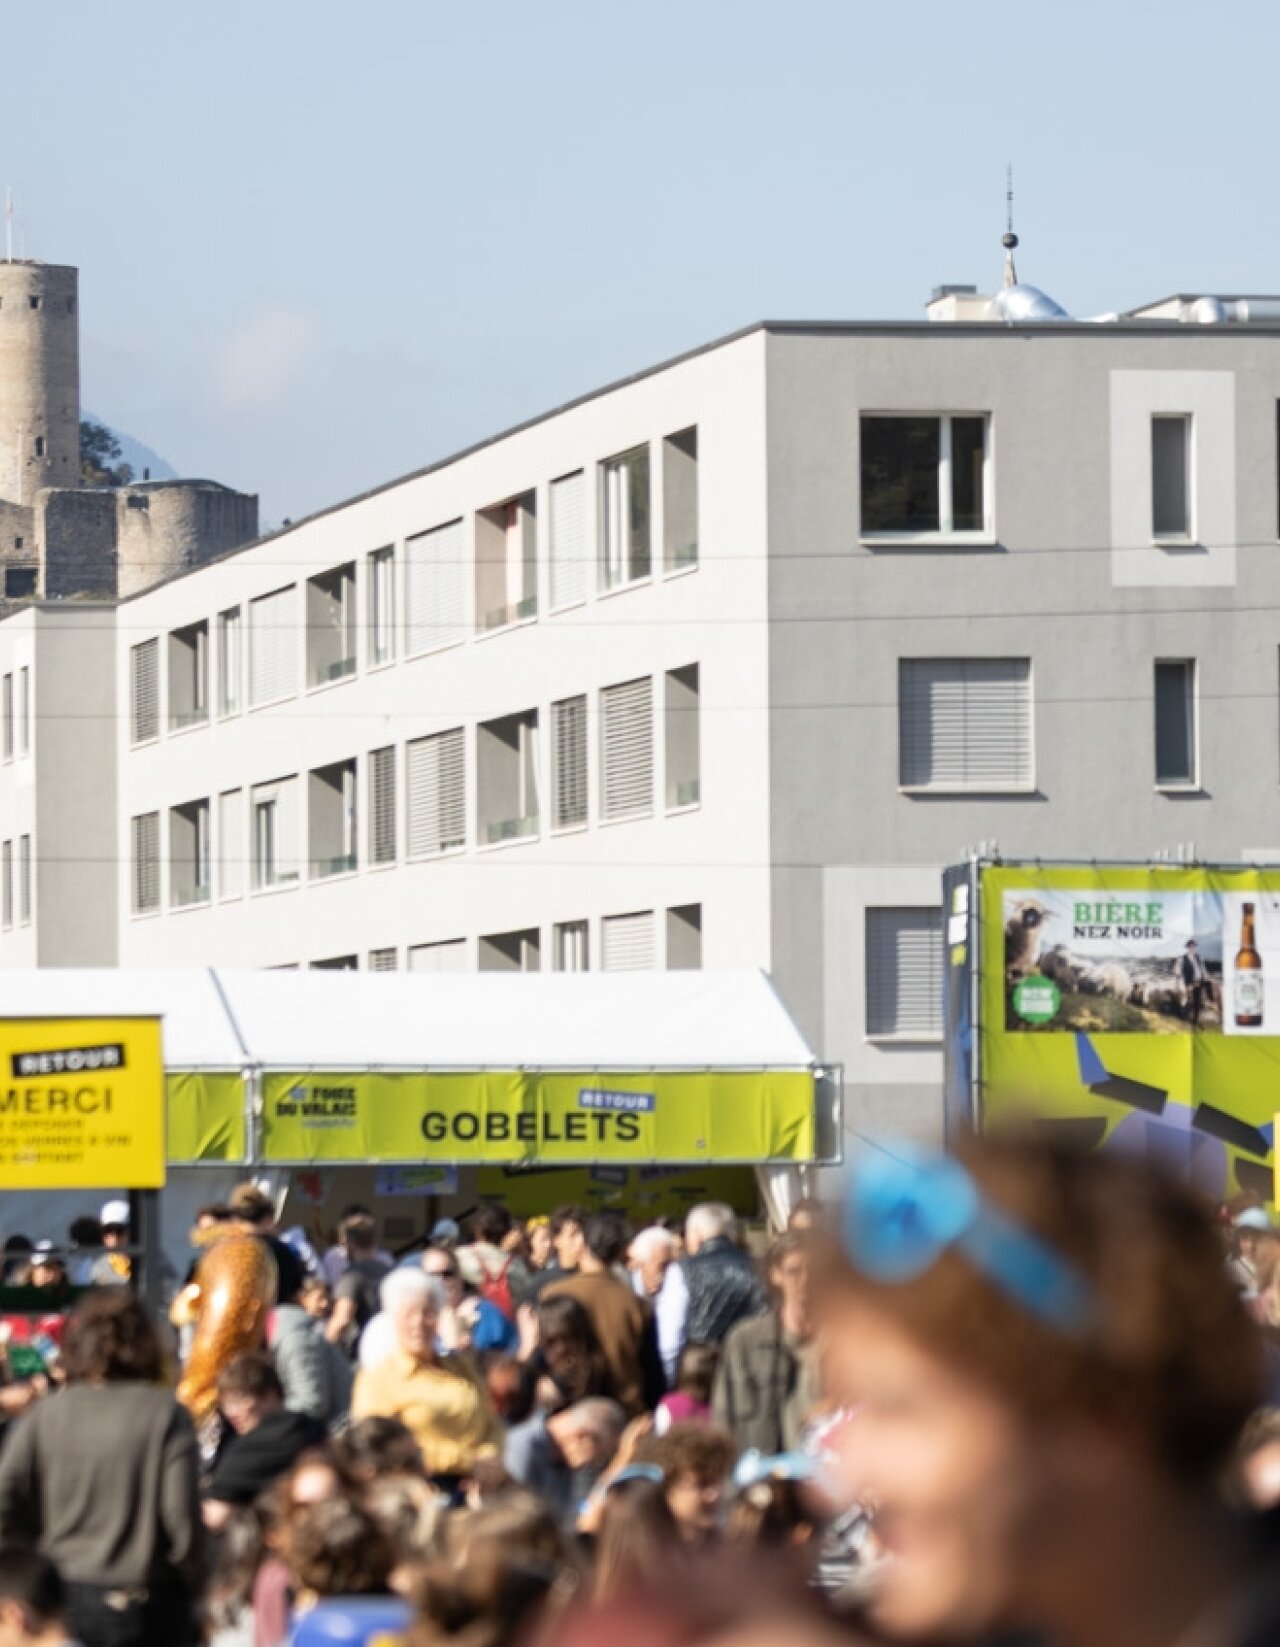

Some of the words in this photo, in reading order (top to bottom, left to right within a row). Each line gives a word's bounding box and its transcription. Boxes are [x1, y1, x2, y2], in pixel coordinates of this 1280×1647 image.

[1073, 896, 1164, 924] BIÈRE
[1073, 925, 1112, 939] NEZ
[1116, 925, 1163, 939] NOIR
[20, 1046, 120, 1076] RETOUR
[582, 1090, 650, 1109] RETOUR
[420, 1110, 642, 1143] GOBELETS
